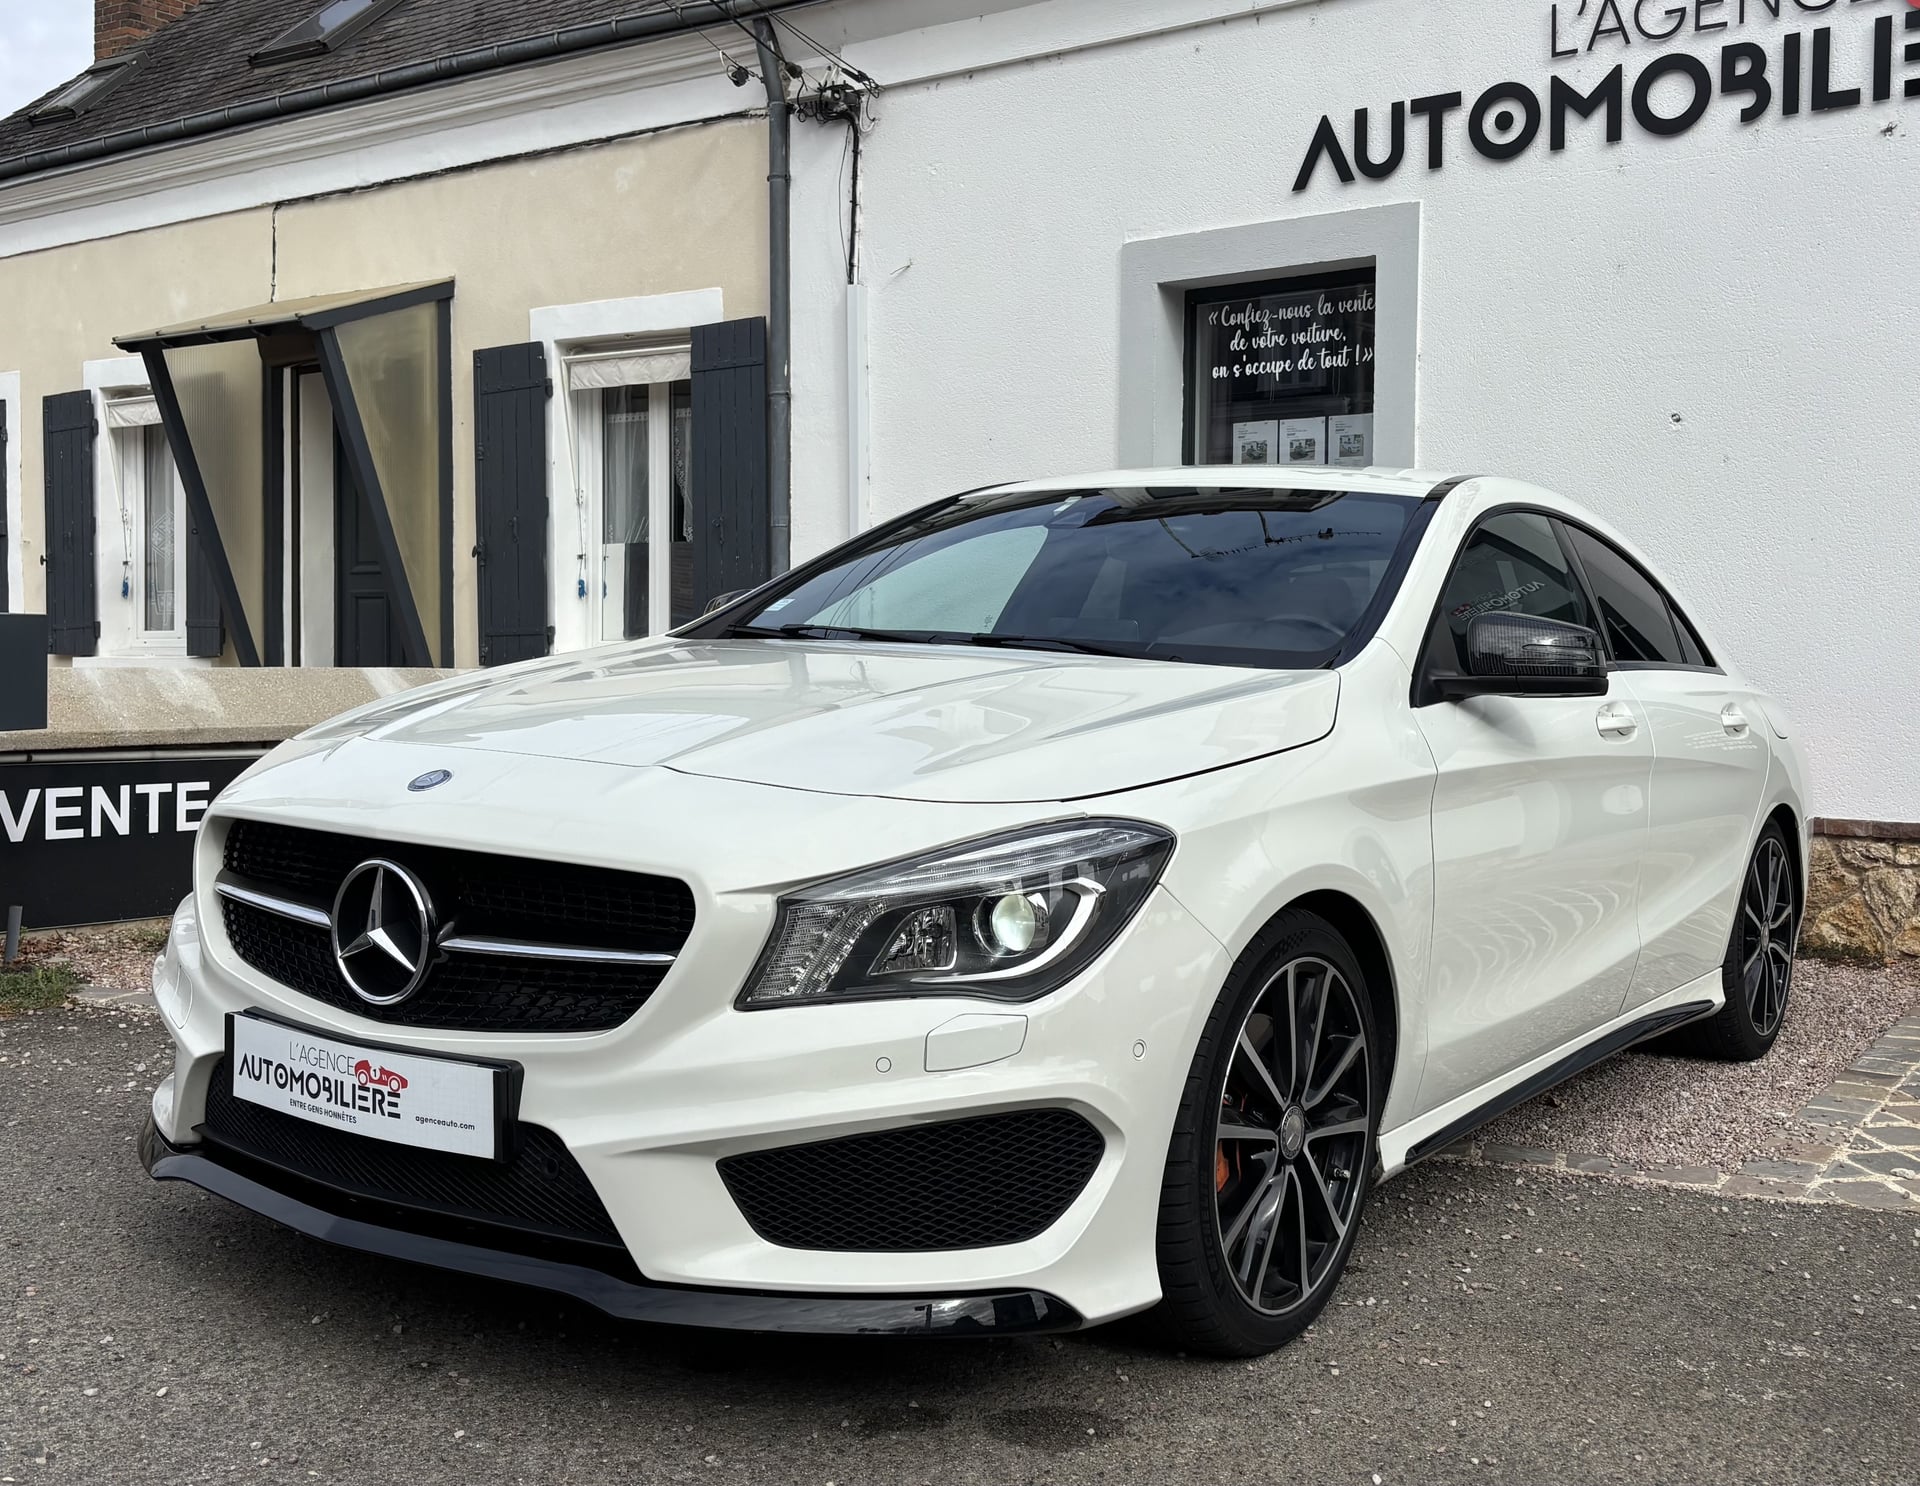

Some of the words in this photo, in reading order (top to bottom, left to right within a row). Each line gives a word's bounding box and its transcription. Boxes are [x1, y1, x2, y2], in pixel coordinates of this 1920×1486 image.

[1317, 293, 1335, 316] la
[1338, 289, 1376, 313] vente
[1229, 329, 1249, 351] de
[1252, 327, 1288, 349] votre
[1212, 365, 1230, 379] on
[1232, 354, 1294, 382] s'occupe
[1297, 348, 1317, 370] de
[1316, 345, 1353, 369] tout
[0, 781, 210, 842] VENTE
[289, 1040, 356, 1077] L'AGENCE
[289, 1098, 307, 1111] ENTRE
[307, 1104, 324, 1116] GENS
[323, 1109, 357, 1125] HONNÊTES
[414, 1114, 476, 1131] agenceauto.com
